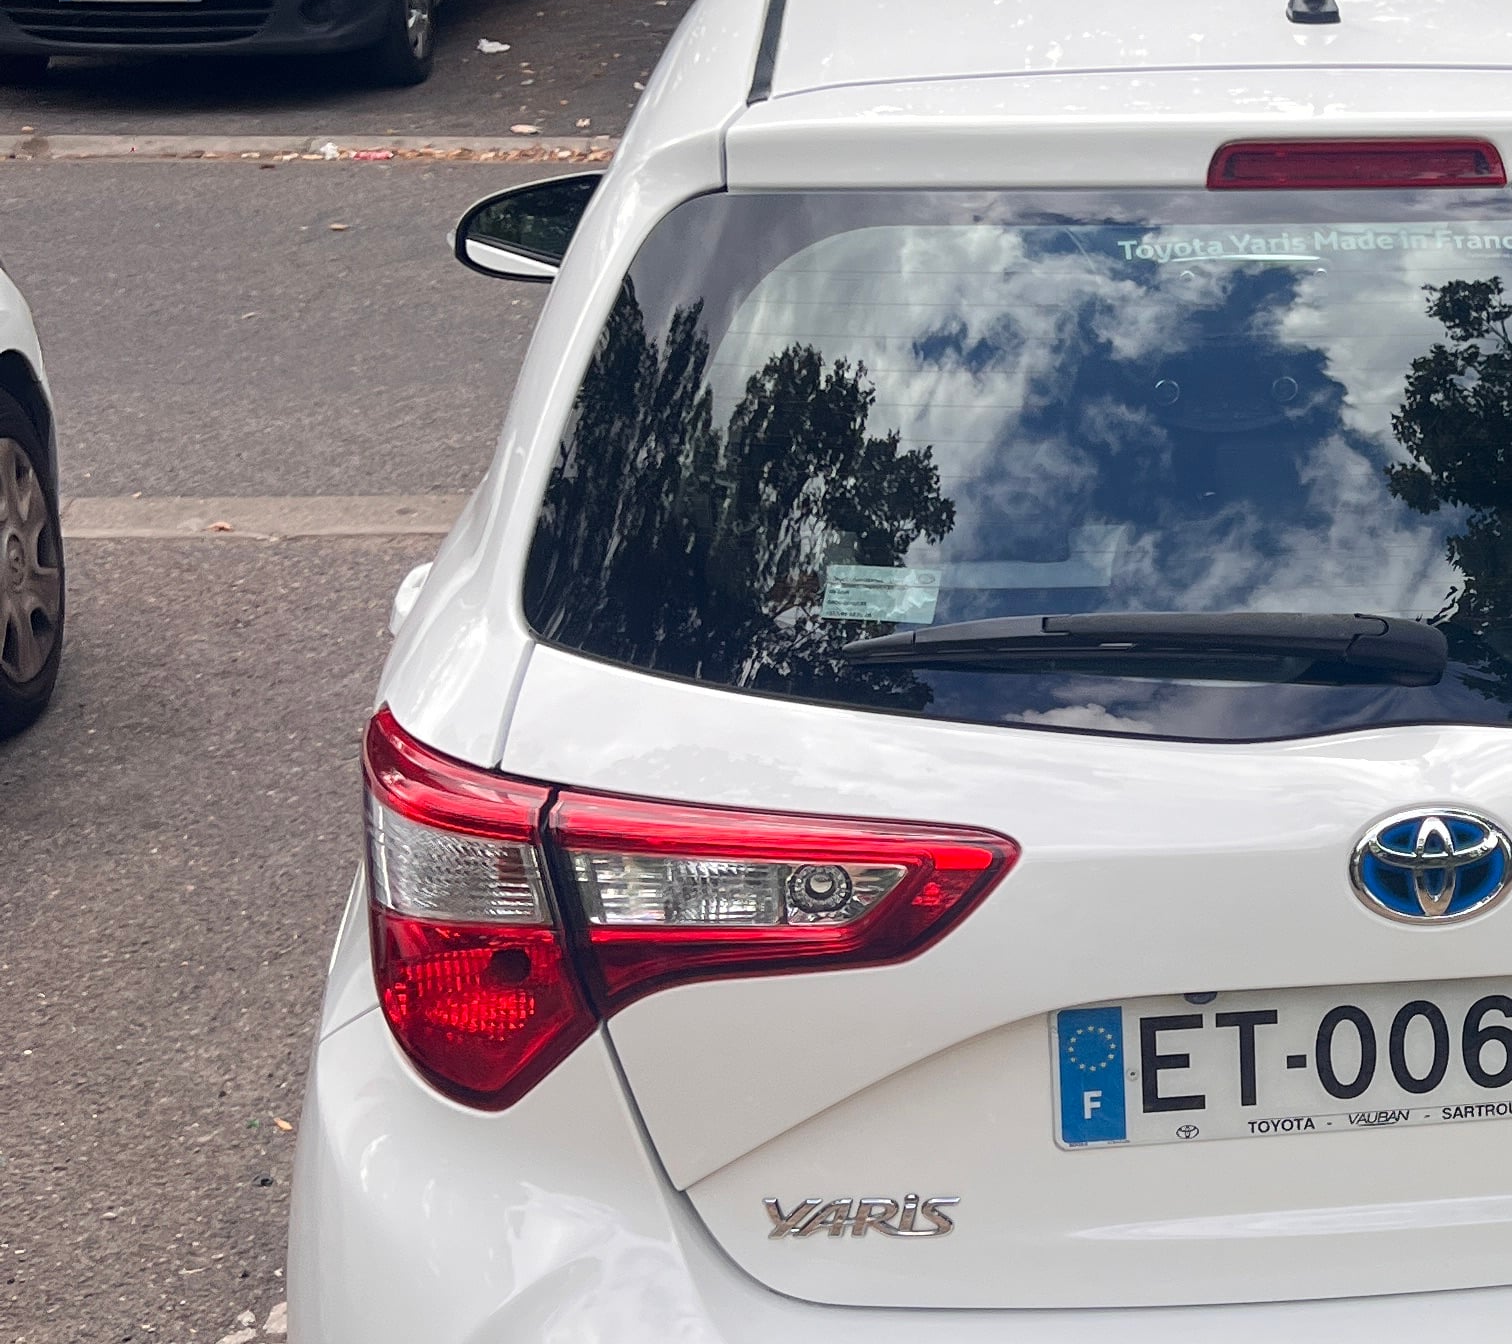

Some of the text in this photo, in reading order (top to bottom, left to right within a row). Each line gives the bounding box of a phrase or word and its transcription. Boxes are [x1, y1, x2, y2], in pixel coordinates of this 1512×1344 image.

[1117, 239, 1224, 263] Toyota
[1229, 232, 1308, 254] Yaris
[1313, 230, 1394, 251] Made
[1399, 229, 1429, 249] in
[1083, 1089, 1103, 1120] F
[1248, 1117, 1316, 1135] TOYOTA
[1347, 1109, 1410, 1126] VAUBAN
